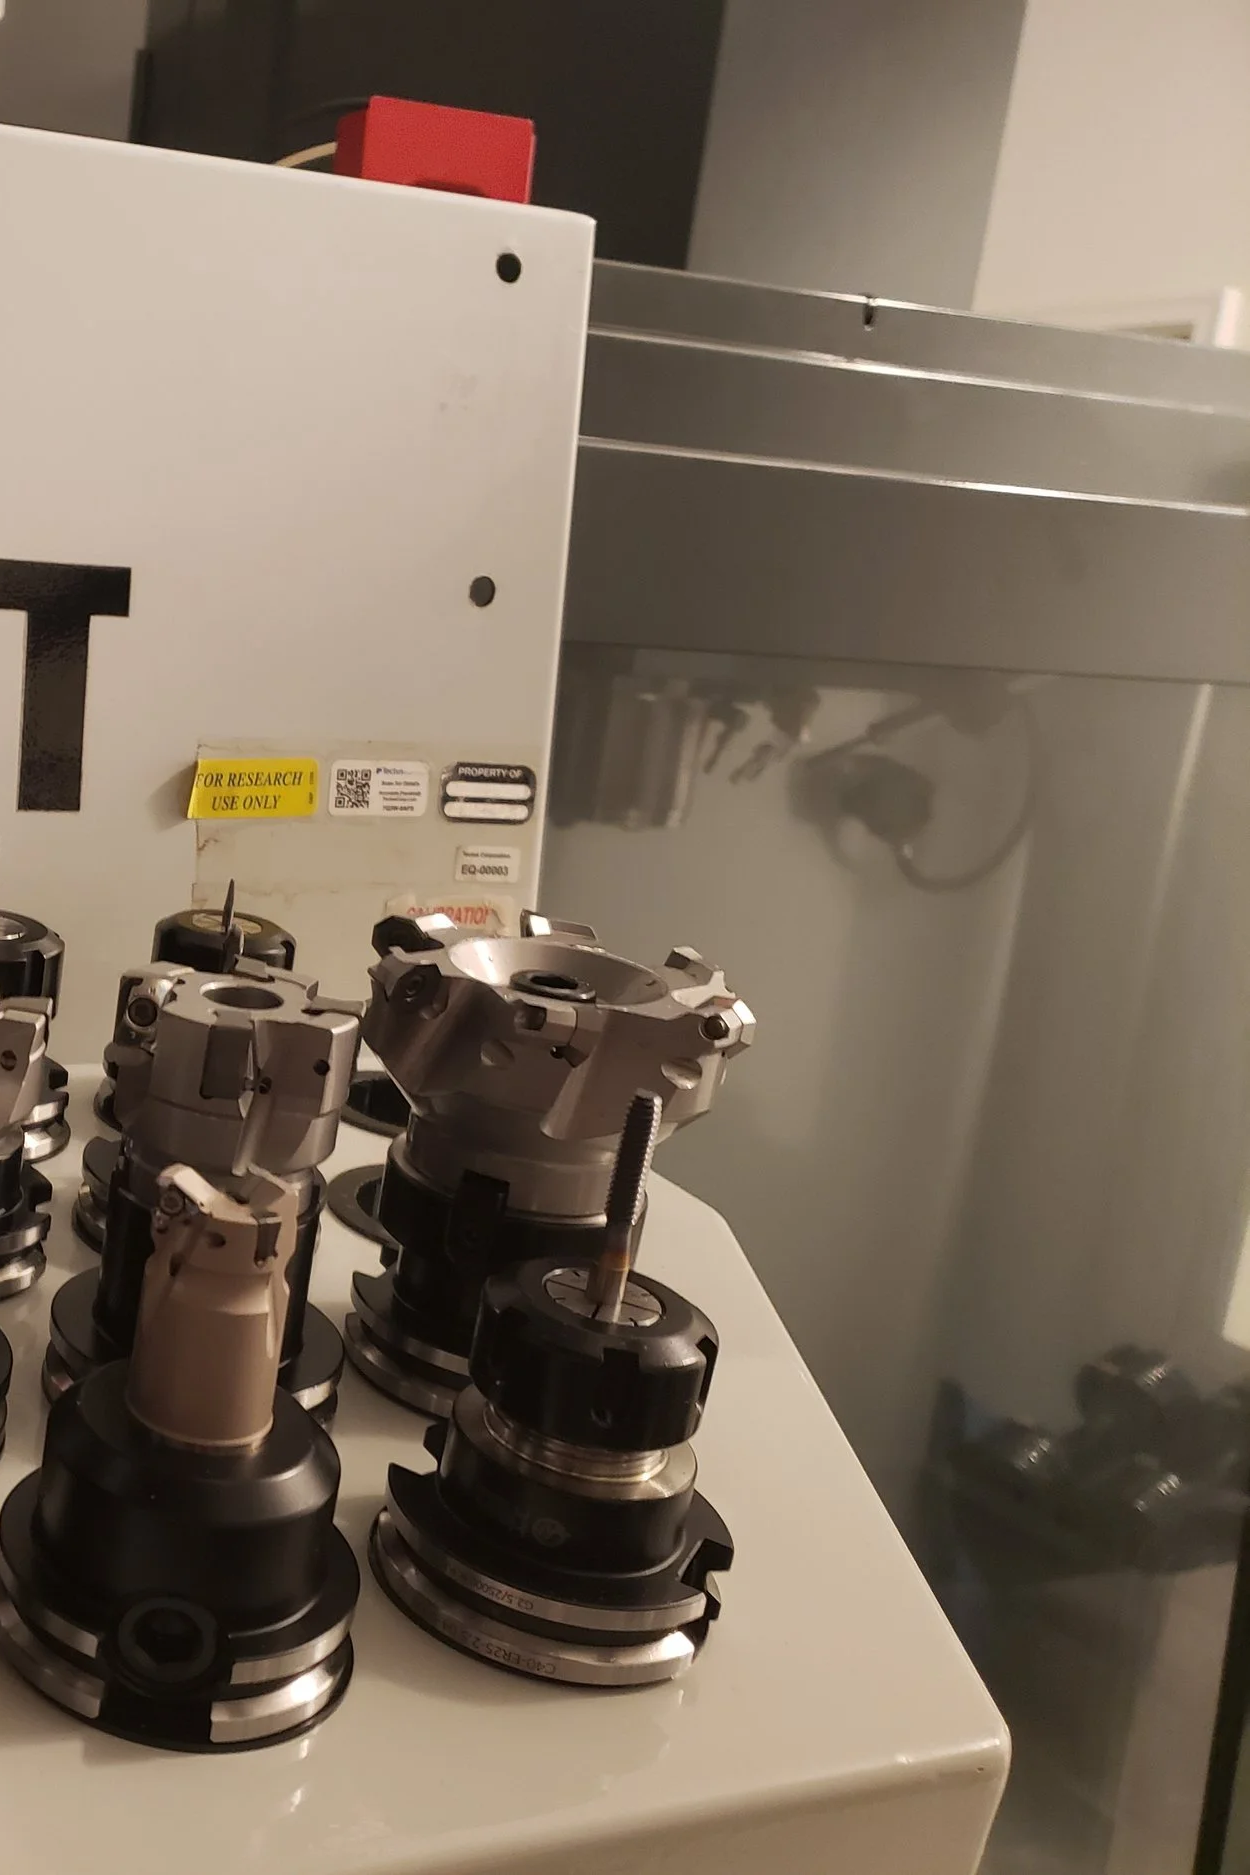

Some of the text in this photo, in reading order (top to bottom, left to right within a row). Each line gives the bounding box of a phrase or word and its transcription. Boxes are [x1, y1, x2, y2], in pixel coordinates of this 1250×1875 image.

[227, 771, 303, 788] RESEARCH
[458, 766, 524, 779] PROPERTY OF
[211, 794, 281, 811] USE ONLY
[460, 864, 509, 876] EQ-00003
